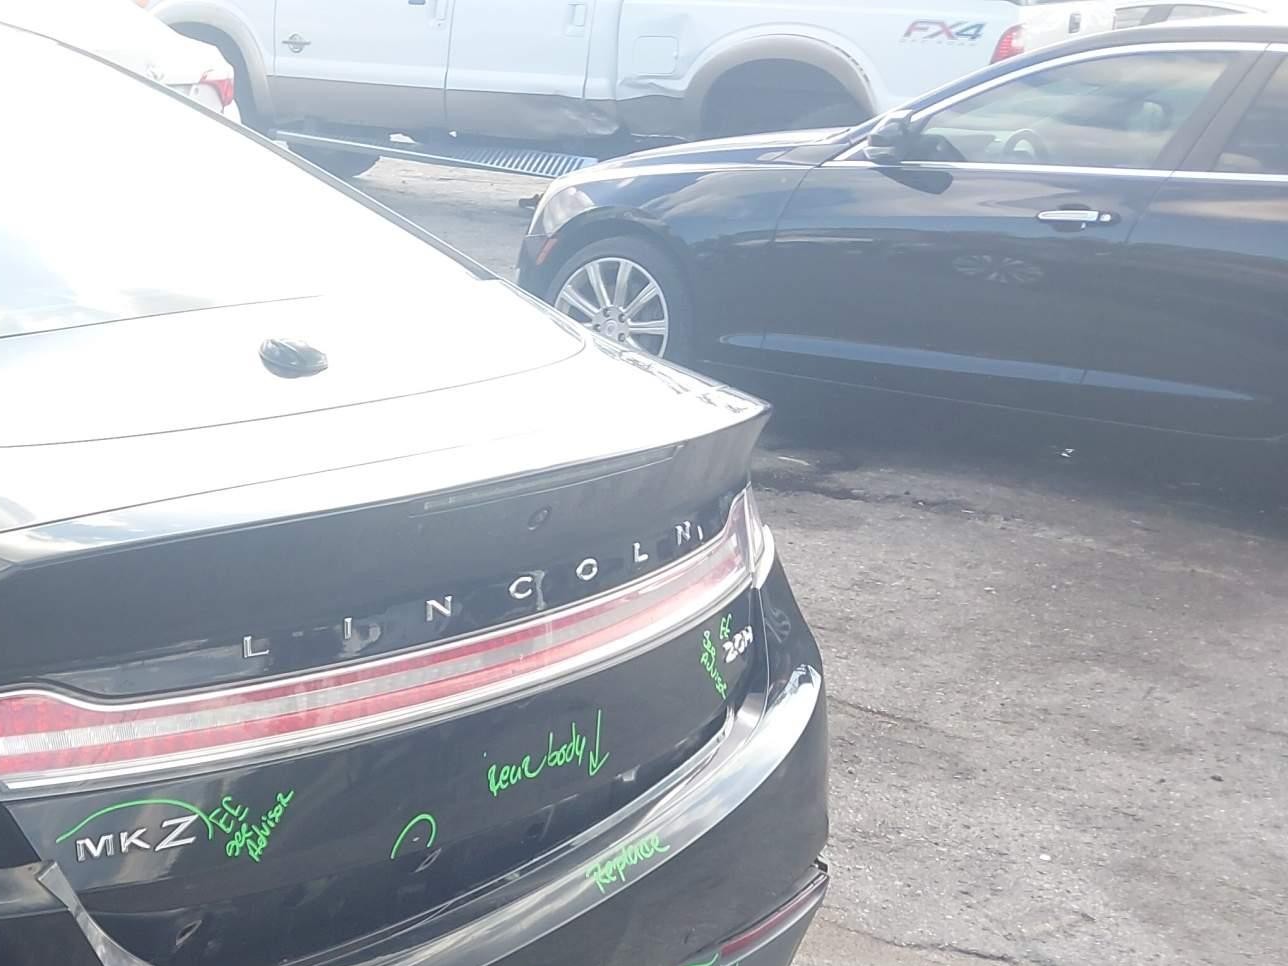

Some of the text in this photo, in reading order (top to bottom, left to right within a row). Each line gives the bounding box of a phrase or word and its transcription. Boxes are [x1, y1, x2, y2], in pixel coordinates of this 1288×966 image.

[903, 19, 986, 40] FX4
[243, 520, 693, 658] LINCOLN
[76, 814, 201, 862] MKZ
